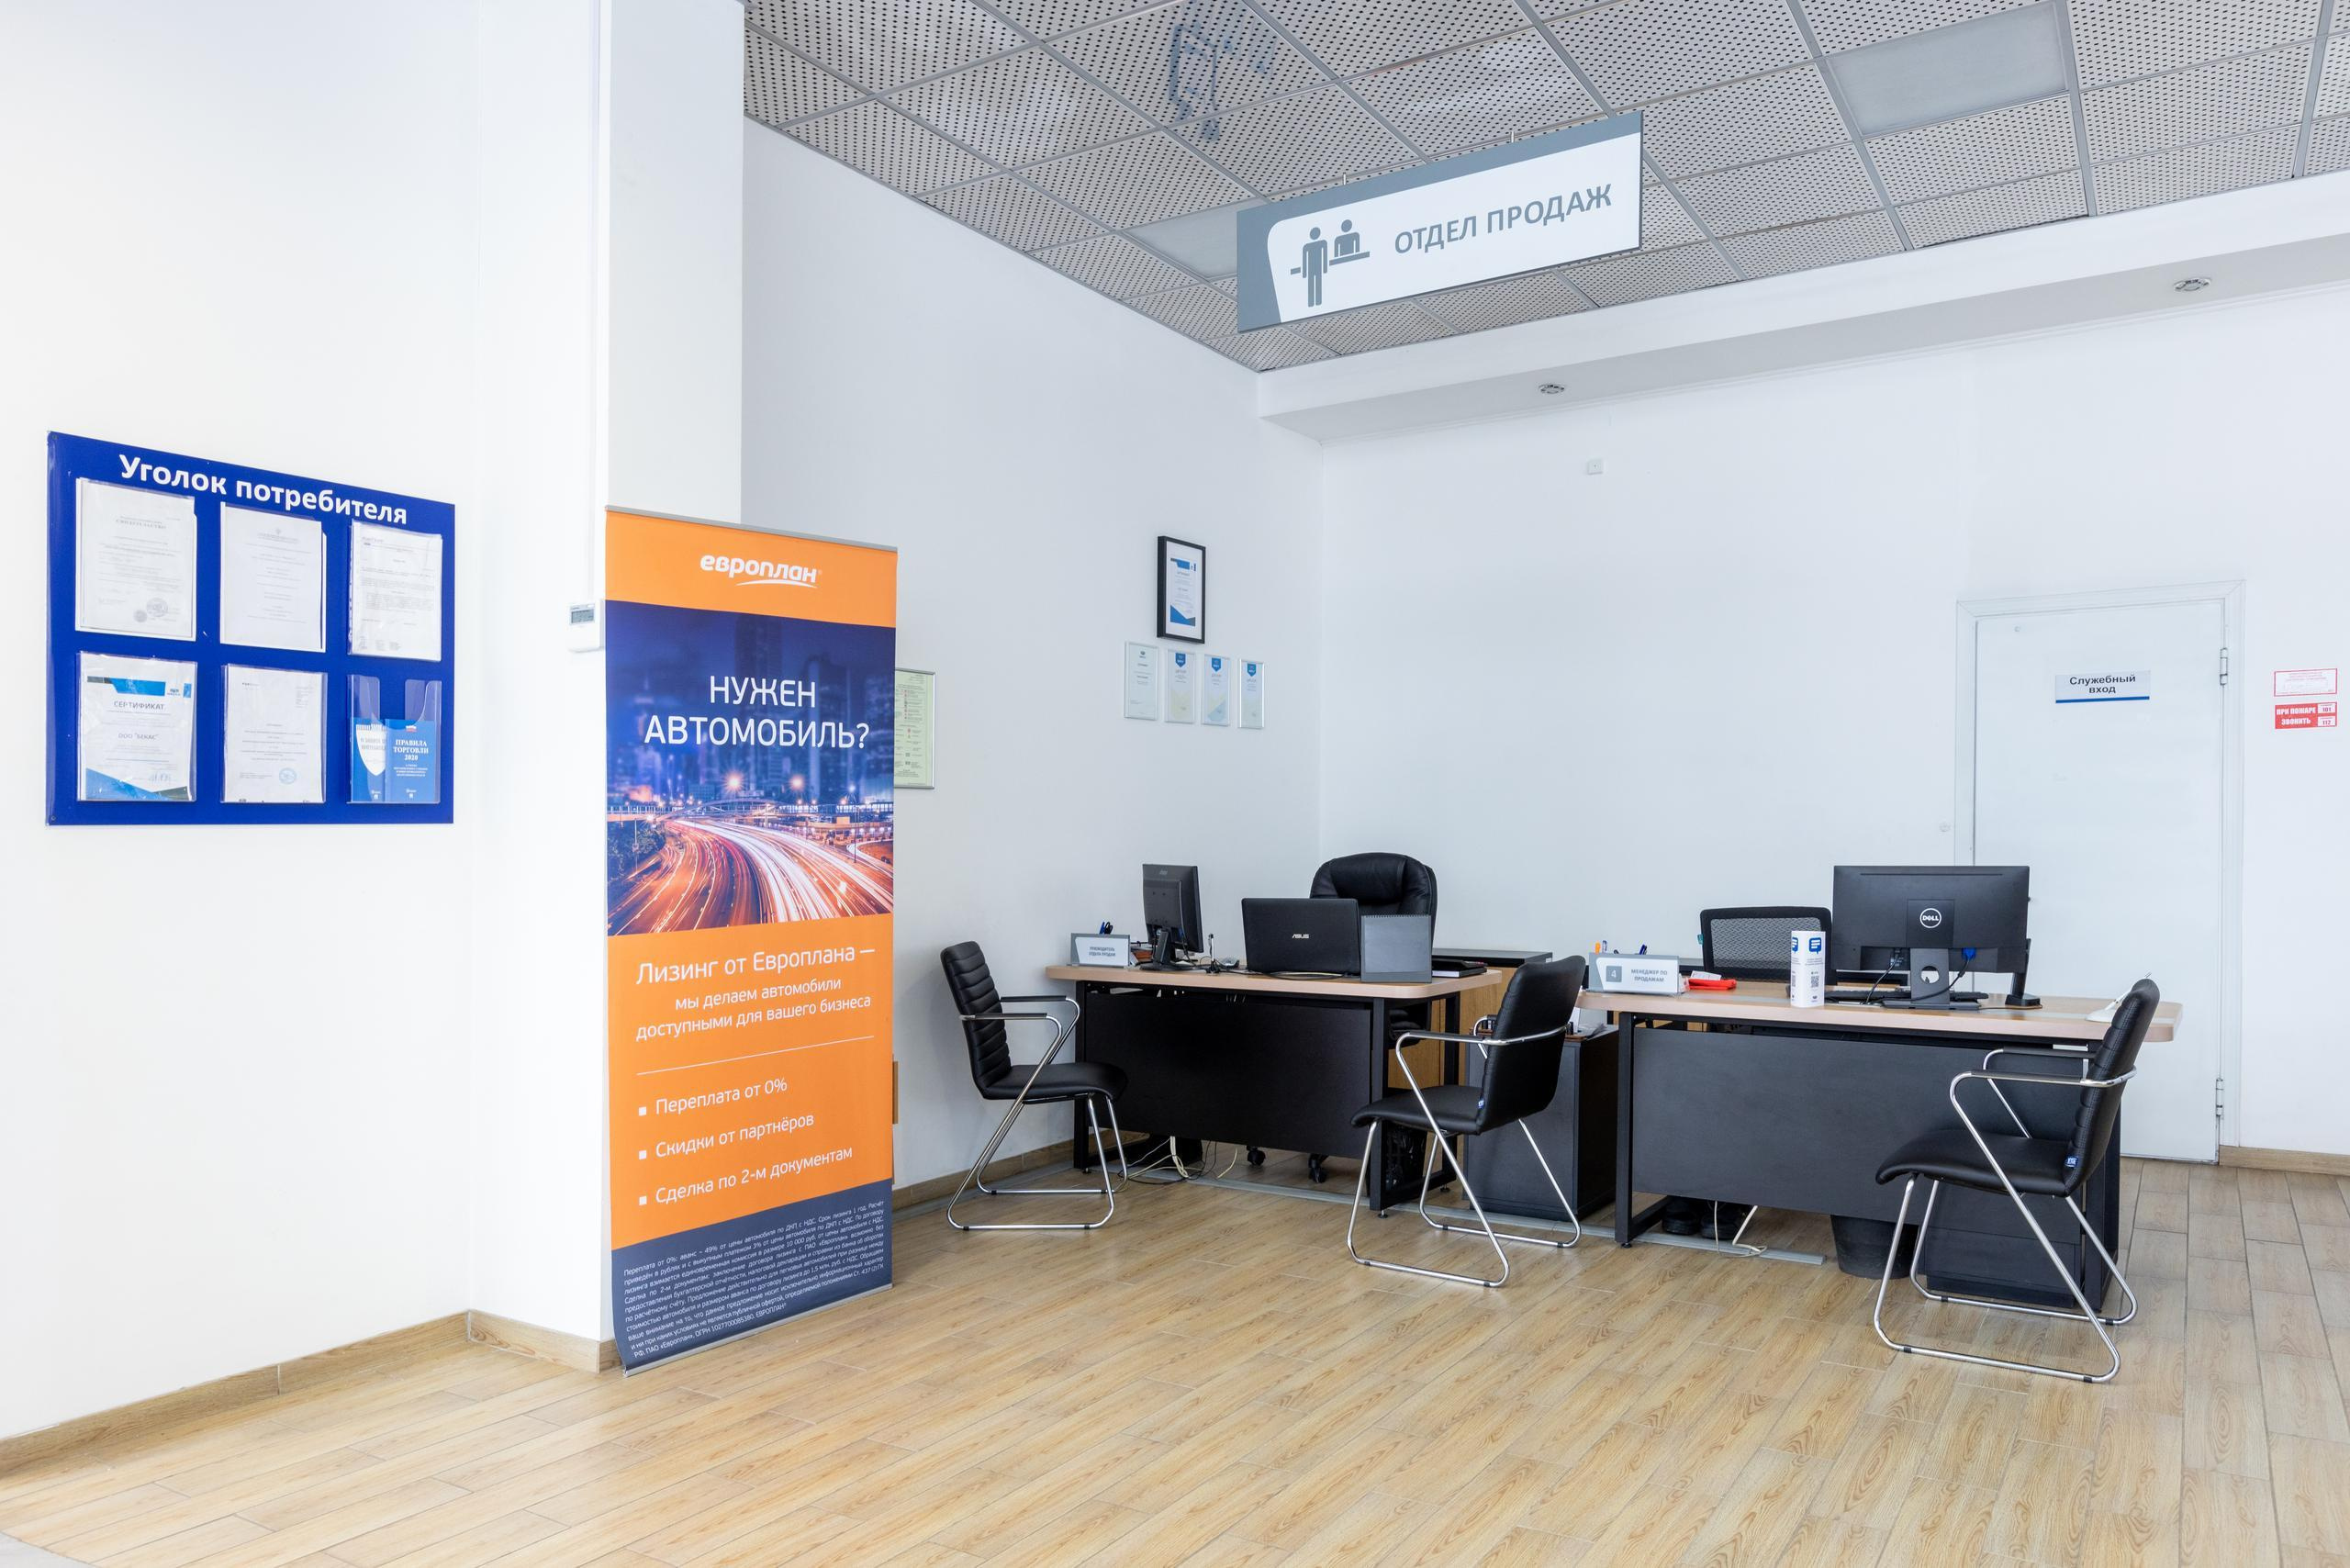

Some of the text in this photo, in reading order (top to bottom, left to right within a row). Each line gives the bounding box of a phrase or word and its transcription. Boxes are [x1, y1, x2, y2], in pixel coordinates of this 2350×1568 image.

[1394, 184, 1613, 254] ОТДЕЛ ПРОДАЖ
[118, 454, 408, 524] Уголок потребителя
[699, 554, 817, 583] европлан
[710, 675, 815, 708] НУЖЕН
[2069, 672, 2137, 687] Служебный
[2088, 685, 2116, 696] вход
[114, 700, 164, 711] СЕРТИФИКАТ
[396, 739, 427, 747] ПРАВИЛА
[644, 714, 869, 748] АВТОМОБИЛЬ?
[393, 746, 429, 755] ТОРГОВЛИ
[636, 960, 718, 985] Лизинг
[723, 958, 746, 975] от
[753, 946, 856, 974] Европлана
[1611, 969, 1617, 978] 4
[676, 978, 841, 1011] мы делаем автомобили
[636, 996, 871, 1042] доступными для вашего бизнеса
[655, 1078, 788, 1115] Переплата от 0%
[655, 1114, 814, 1158] Скидки от партнёров
[655, 1147, 853, 1204] Сделка по 2-м документам
